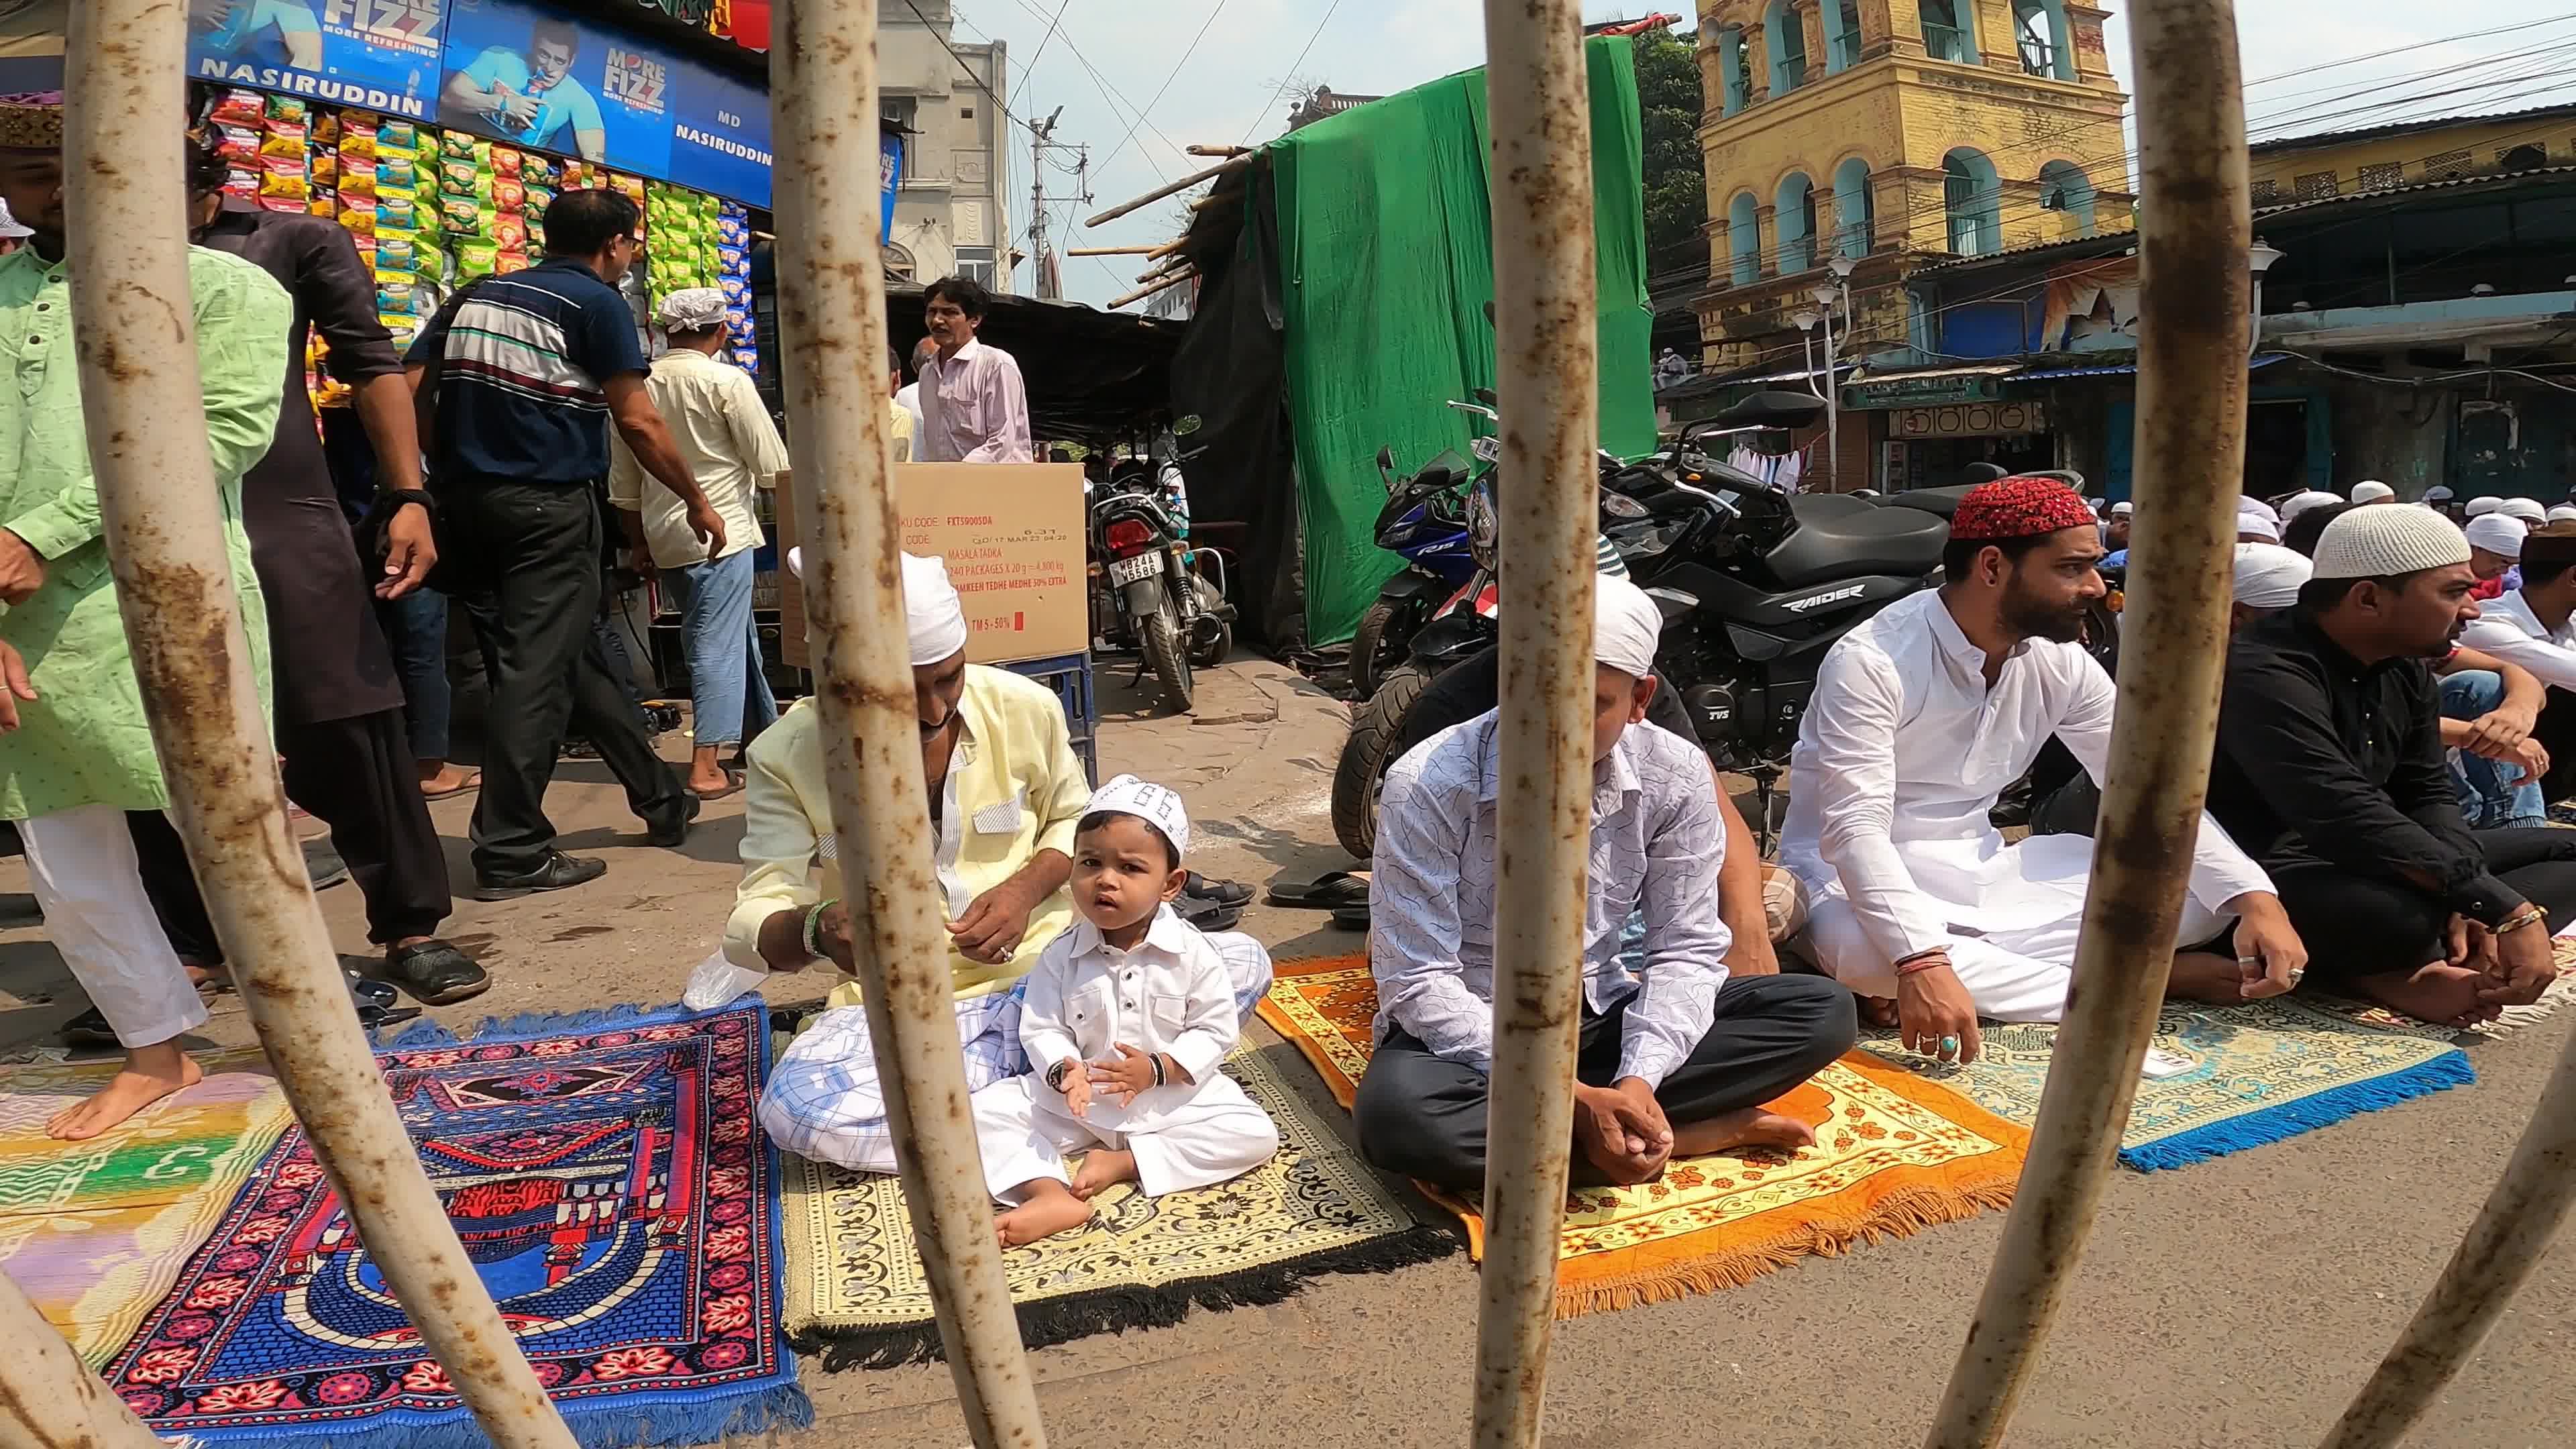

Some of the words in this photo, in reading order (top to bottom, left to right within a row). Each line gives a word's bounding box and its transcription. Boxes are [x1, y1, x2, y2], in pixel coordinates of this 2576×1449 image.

[324, 0, 439, 49] FIZZ
[323, 23, 361, 40] MORE
[364, 34, 439, 59] REFRESHING
[201, 56, 423, 117] NASIRUDDIN
[603, 64, 666, 108] FIZZ
[717, 109, 741, 128] MD
[676, 123, 773, 166] NASIRUDDIN
[914, 517, 939, 527] CODE
[906, 535, 930, 545] CODE
[947, 547, 977, 560] MASALA
[979, 547, 1002, 559] TADKA
[965, 563, 1004, 576] PACKAGES
[1011, 562, 1020, 573] 20
[985, 580, 1008, 591] TEDHE
[1008, 578, 1032, 590] MEDHE
[1047, 576, 1067, 586] EXTRA
[1781, 584, 1866, 613] RAIDER
[1709, 710, 1730, 720] TVS
